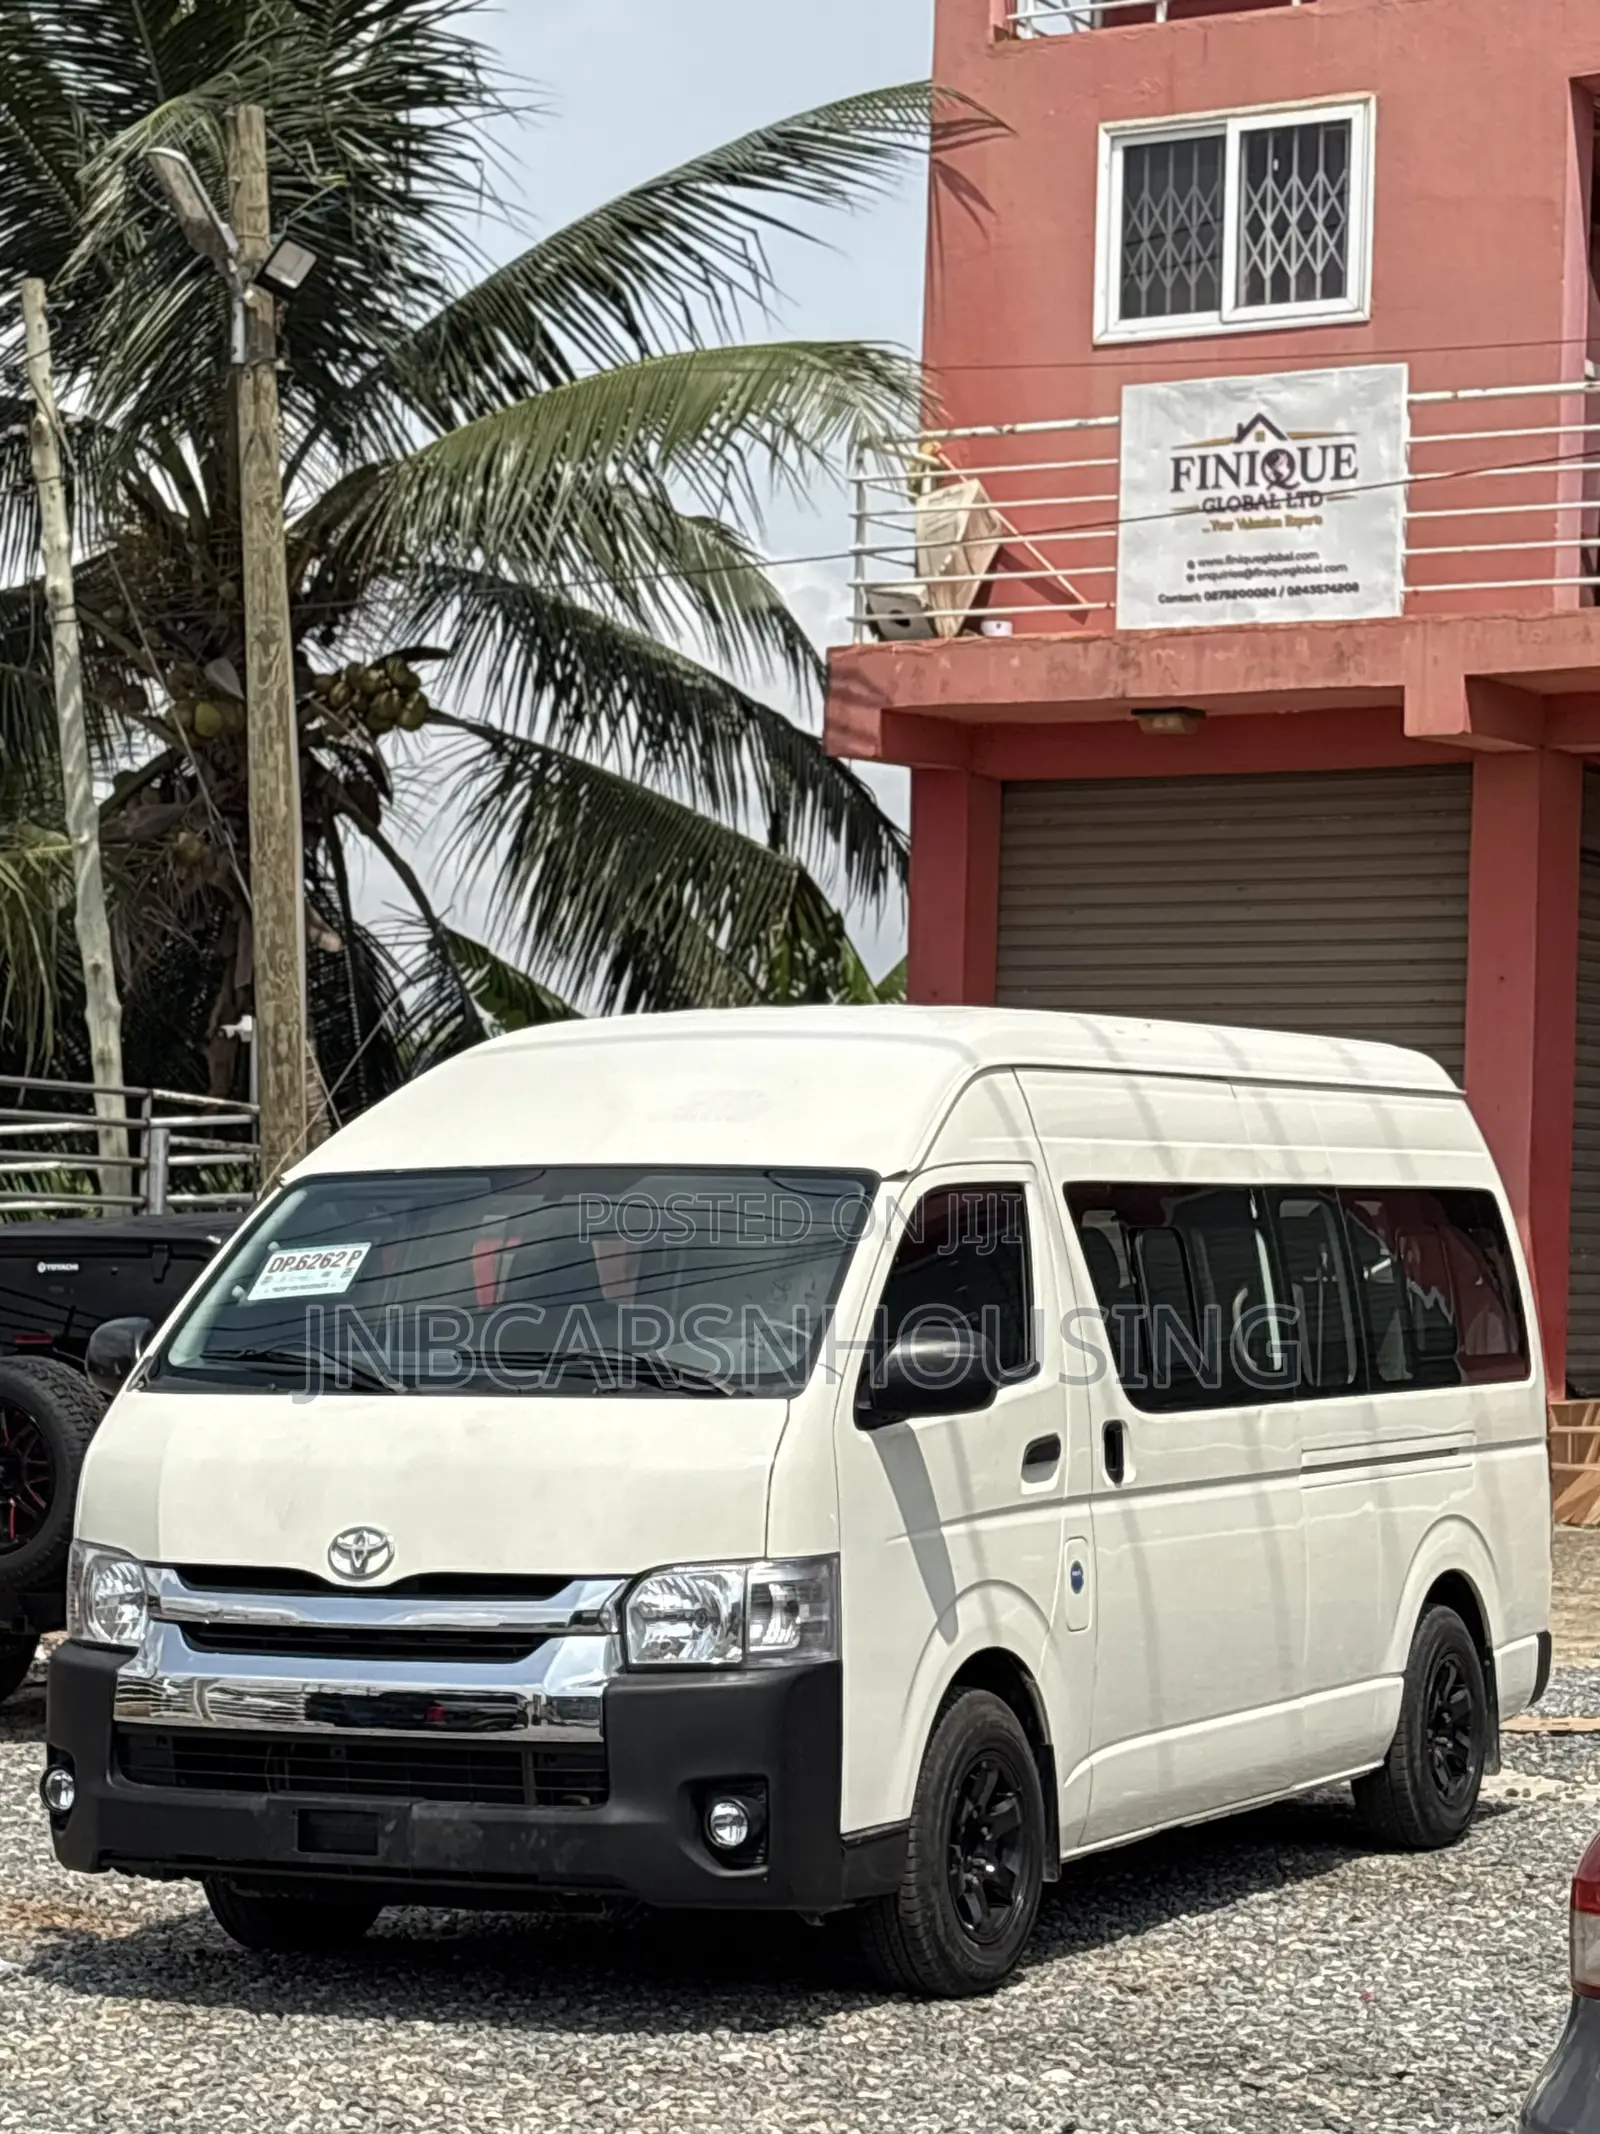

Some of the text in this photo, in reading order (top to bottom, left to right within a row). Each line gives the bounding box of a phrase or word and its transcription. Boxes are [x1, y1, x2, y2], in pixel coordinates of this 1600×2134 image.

[1170, 443, 1359, 493] FINIQUE
[1202, 490, 1323, 513] GLOBAL LTD
[1197, 551, 1319, 569] www.finiqueglobal.com
